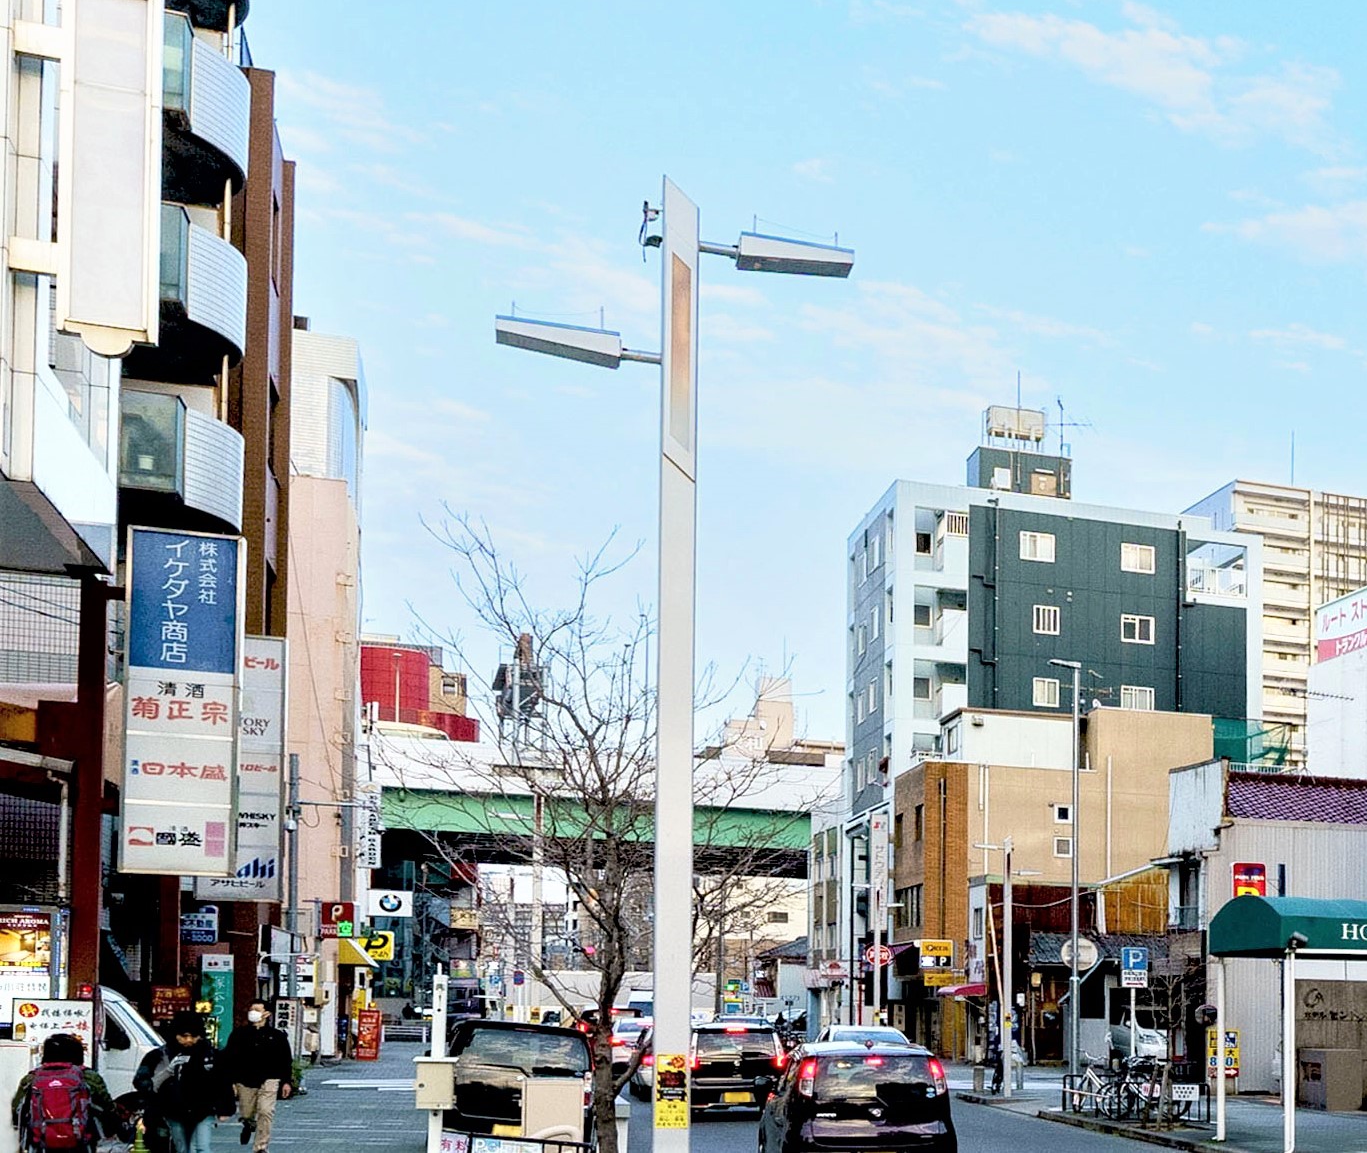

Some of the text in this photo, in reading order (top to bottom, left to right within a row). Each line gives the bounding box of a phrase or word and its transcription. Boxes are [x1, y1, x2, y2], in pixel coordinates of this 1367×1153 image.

[198, 541, 218, 605] 株式会社
[160, 540, 190, 664] イケダヤ商店
[1322, 608, 1347, 633] ルート
[157, 681, 205, 698] 清酒
[132, 696, 228, 725] 菊正宗
[142, 762, 228, 781] 日本盛
[210, 878, 266, 889] アサヒビール
[939, 956, 947, 966] P
[1129, 950, 1143, 968] P
[440, 1138, 466, 1151] 有料
